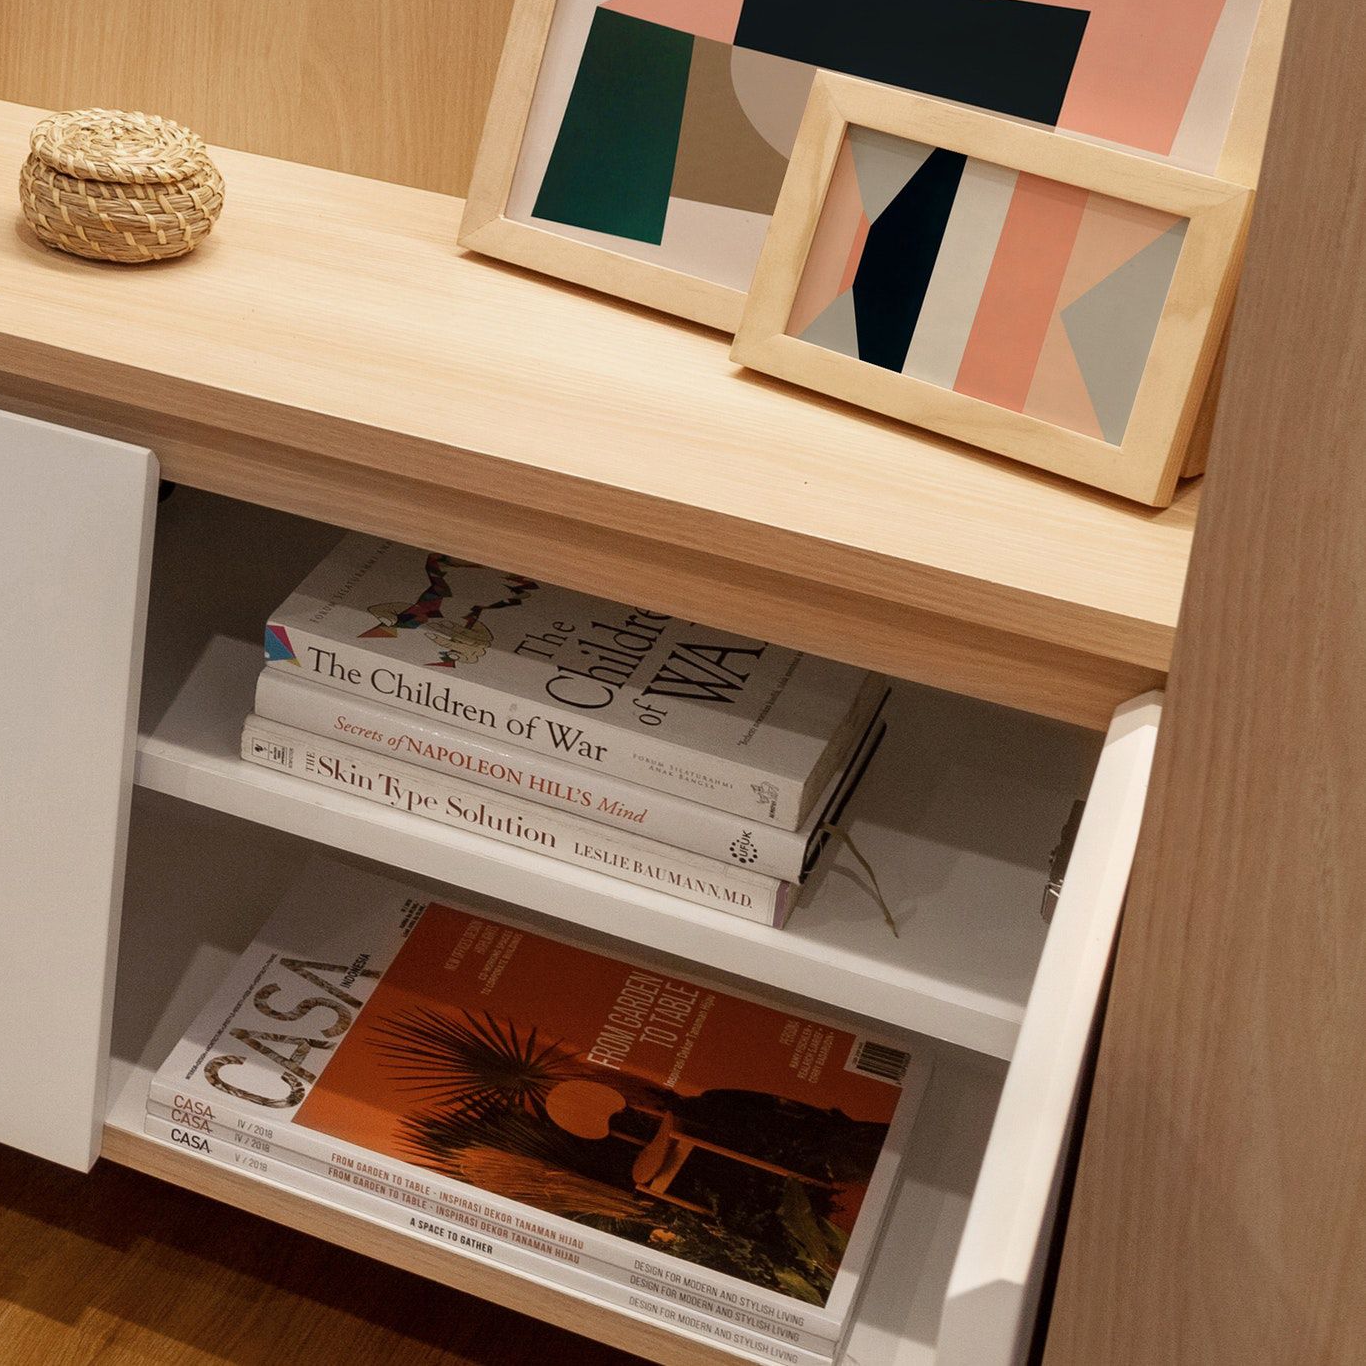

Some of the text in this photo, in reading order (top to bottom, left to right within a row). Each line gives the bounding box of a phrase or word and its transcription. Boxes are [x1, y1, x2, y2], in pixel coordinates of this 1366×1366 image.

[515, 621, 575, 659] The
[546, 606, 673, 709] Childre
[641, 624, 768, 704] WA
[308, 646, 607, 762] The Children of War
[632, 698, 668, 726] of
[305, 751, 316, 773] THE
[318, 755, 372, 791] Skin
[378, 773, 438, 811] Type
[445, 795, 556, 848] Solution
[334, 715, 649, 824] Secrets of NAPOLEON HILL'S Mind
[632, 753, 666, 770] FORUM
[574, 842, 630, 871] LESLIE
[739, 830, 752, 858] UFUK
[341, 953, 371, 990] INDONESIA
[204, 957, 381, 1110] CASA
[586, 969, 664, 1070] FROM GARDEN
[638, 981, 700, 1051] TO TABLE
[170, 1128, 213, 1154] CASA
[235, 1153, 241, 1162] V
[247, 1157, 268, 1172] 2018
[410, 1218, 416, 1226] A
[418, 1220, 444, 1237] SPACE
[447, 1230, 458, 1242] TO
[460, 1235, 493, 1255] GATHER
[629, 1296, 657, 1314] DESIGN
[660, 1307, 675, 1320] FOR
[678, 1313, 712, 1333] MODERN
[715, 1327, 732, 1341] AND
[734, 1335, 768, 1353] STYLISH
[771, 1346, 798, 1364] LIVING
[171, 1109, 213, 1134] CASA
[234, 1133, 243, 1144] IV
[251, 1138, 270, 1154] 2018
[328, 1167, 350, 1183] FROM
[353, 1175, 385, 1196] GARDEN
[388, 1188, 399, 1200] TO
[402, 1193, 426, 1210] TABLE
[436, 1207, 478, 1227] INSPIRASI
[481, 1221, 509, 1239] DEKOR
[511, 1231, 552, 1254] TANAMAN
[555, 1247, 580, 1264] HIJAU
[630, 1275, 658, 1293] DESIGN
[661, 1286, 677, 1299] FOR
[680, 1291, 713, 1311] MODERN
[715, 1306, 733, 1319] AND
[735, 1312, 770, 1332] STYLISH
[772, 1325, 799, 1343] LIVING
[174, 1094, 216, 1120] CASA
[237, 1119, 246, 1129] IV
[254, 1123, 273, 1139] 2018
[332, 1153, 354, 1168] FROM
[356, 1161, 388, 1181] GARDEN
[392, 1174, 402, 1186] TO
[405, 1178, 430, 1195] TABLE
[440, 1192, 481, 1213] INSPIRASI
[484, 1206, 513, 1224] DEKOR
[515, 1217, 556, 1240] TANAMAN
[559, 1232, 584, 1250] HIJAU
[634, 1260, 663, 1278] DESIGN
[666, 1271, 681, 1283] FOR
[684, 1276, 717, 1297] MODERN
[720, 1290, 737, 1303] AND
[740, 1297, 775, 1316] STYLISH
[777, 1309, 804, 1327] LIVING
